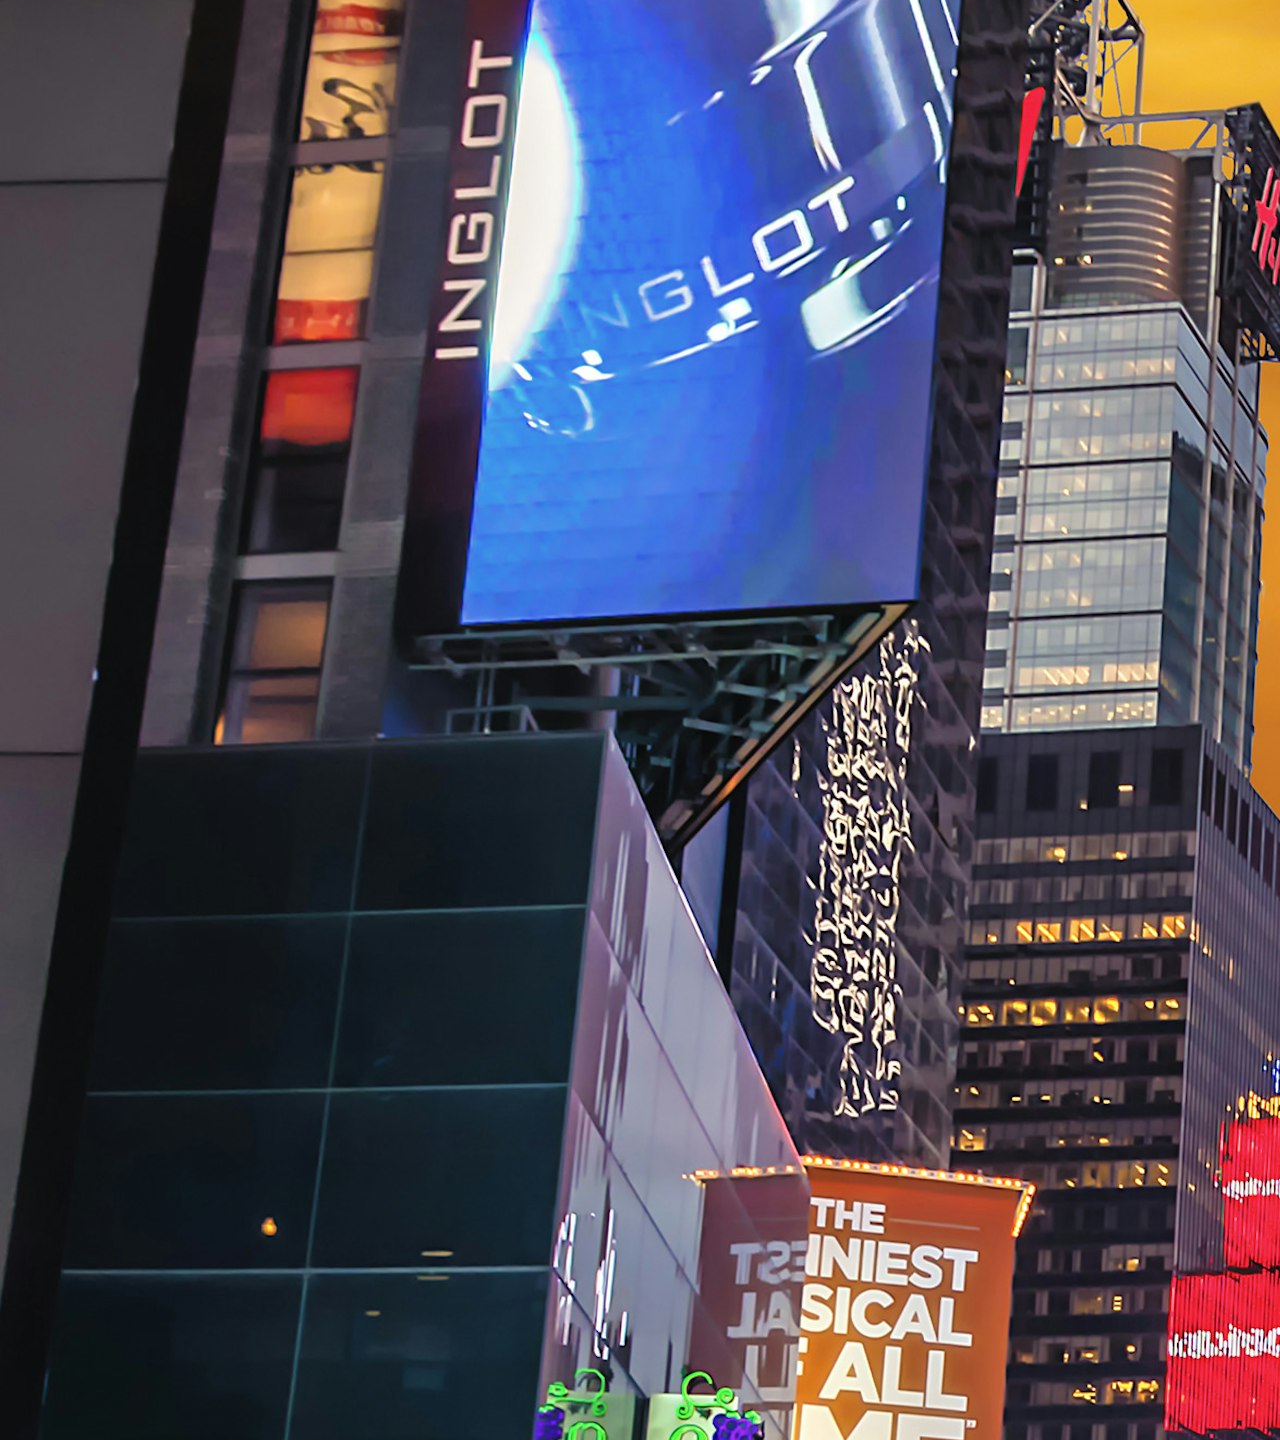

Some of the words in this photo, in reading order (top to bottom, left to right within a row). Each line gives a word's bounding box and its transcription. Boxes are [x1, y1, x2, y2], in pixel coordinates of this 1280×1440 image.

[434, 40, 514, 361] INGLOT
[809, 1196, 887, 1235] THE
[818, 1341, 968, 1412] ALL
